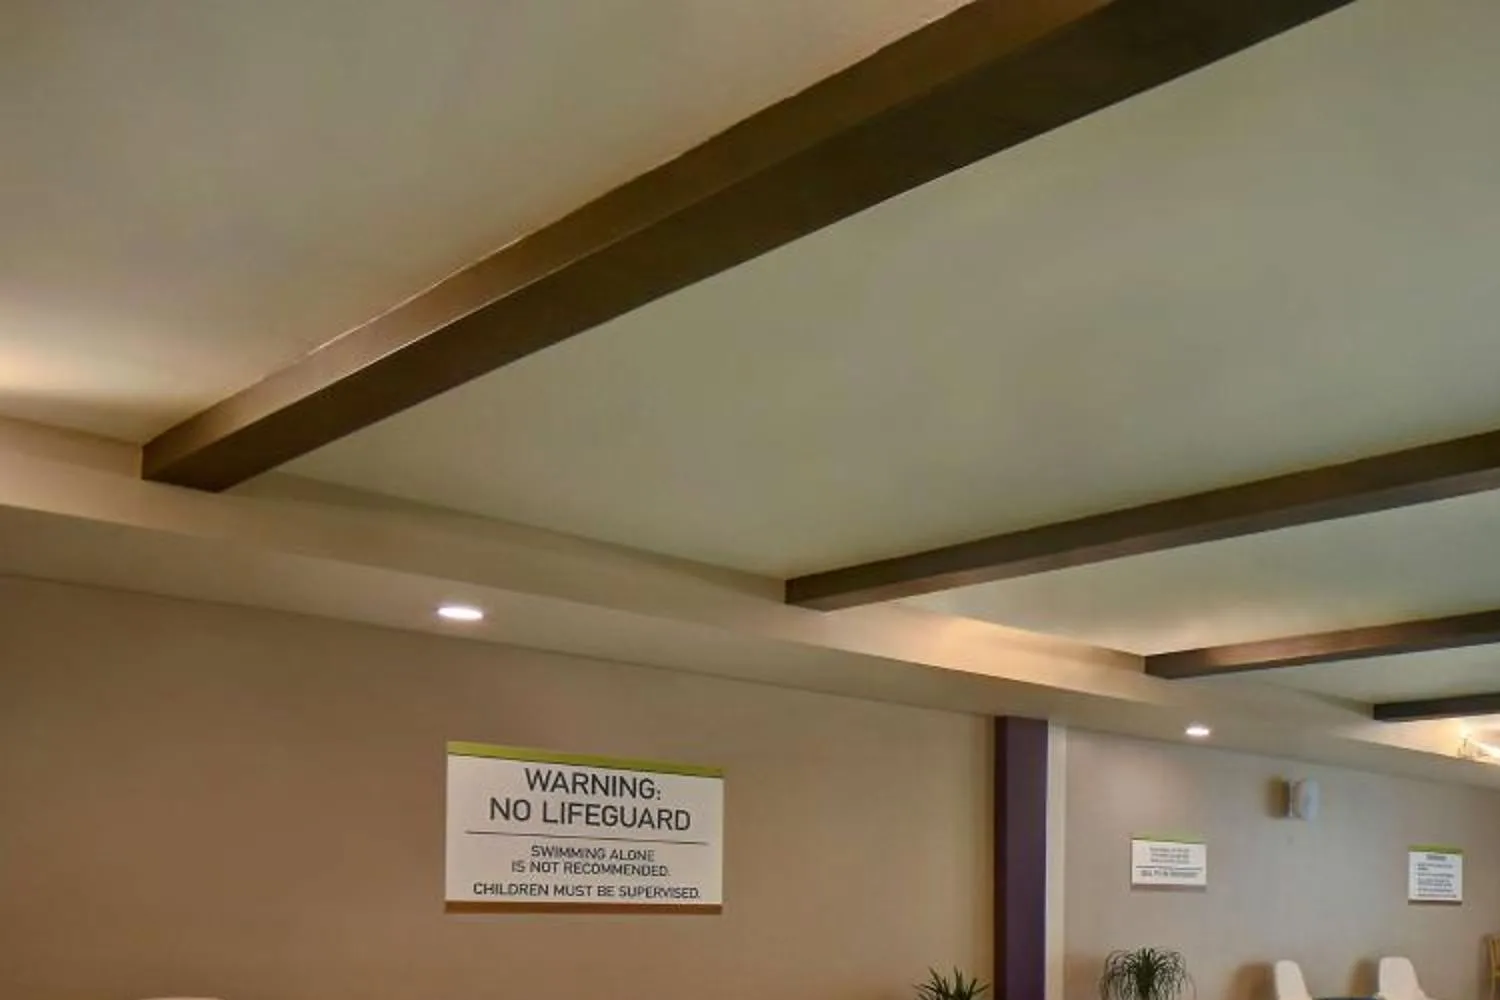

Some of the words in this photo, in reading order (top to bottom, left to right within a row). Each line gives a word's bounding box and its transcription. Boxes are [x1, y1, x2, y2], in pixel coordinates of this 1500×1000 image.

[525, 767, 661, 801] WARNING:
[489, 797, 531, 822] NO
[543, 801, 691, 831] LIFEGUARD
[531, 845, 605, 860] SWIMMING
[609, 848, 655, 862] ALONE
[511, 860, 526, 873] IS
[529, 861, 560, 874] NOT
[472, 882, 549, 897] CHILDREN
[553, 884, 592, 897] MUST
[597, 885, 616, 897] BE
